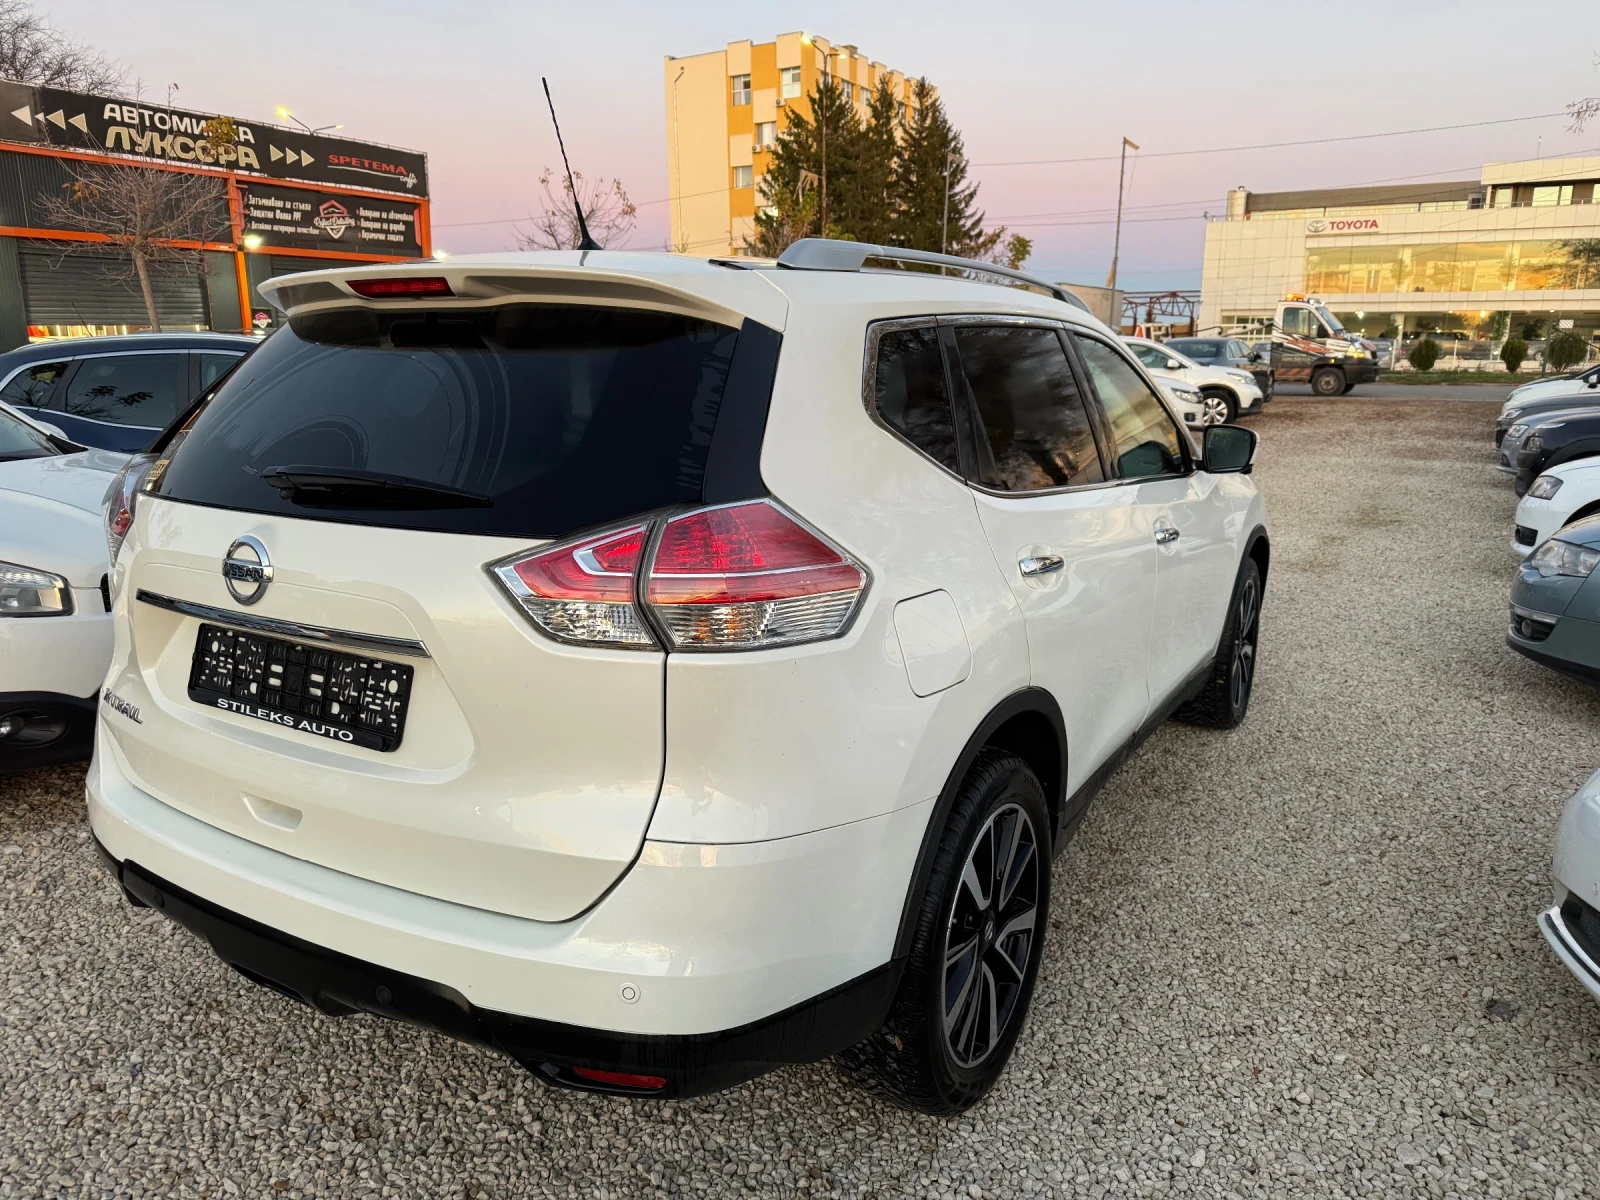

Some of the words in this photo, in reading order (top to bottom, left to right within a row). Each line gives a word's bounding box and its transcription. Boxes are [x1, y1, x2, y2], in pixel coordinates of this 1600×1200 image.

[103, 103, 255, 144] АВТОМИА
[105, 125, 260, 169] ЛУКСОРА
[328, 154, 408, 176] SPETEMA
[1329, 219, 1379, 231] TOYOTA
[217, 698, 294, 726] STILEKS
[298, 719, 354, 741] AUTO
